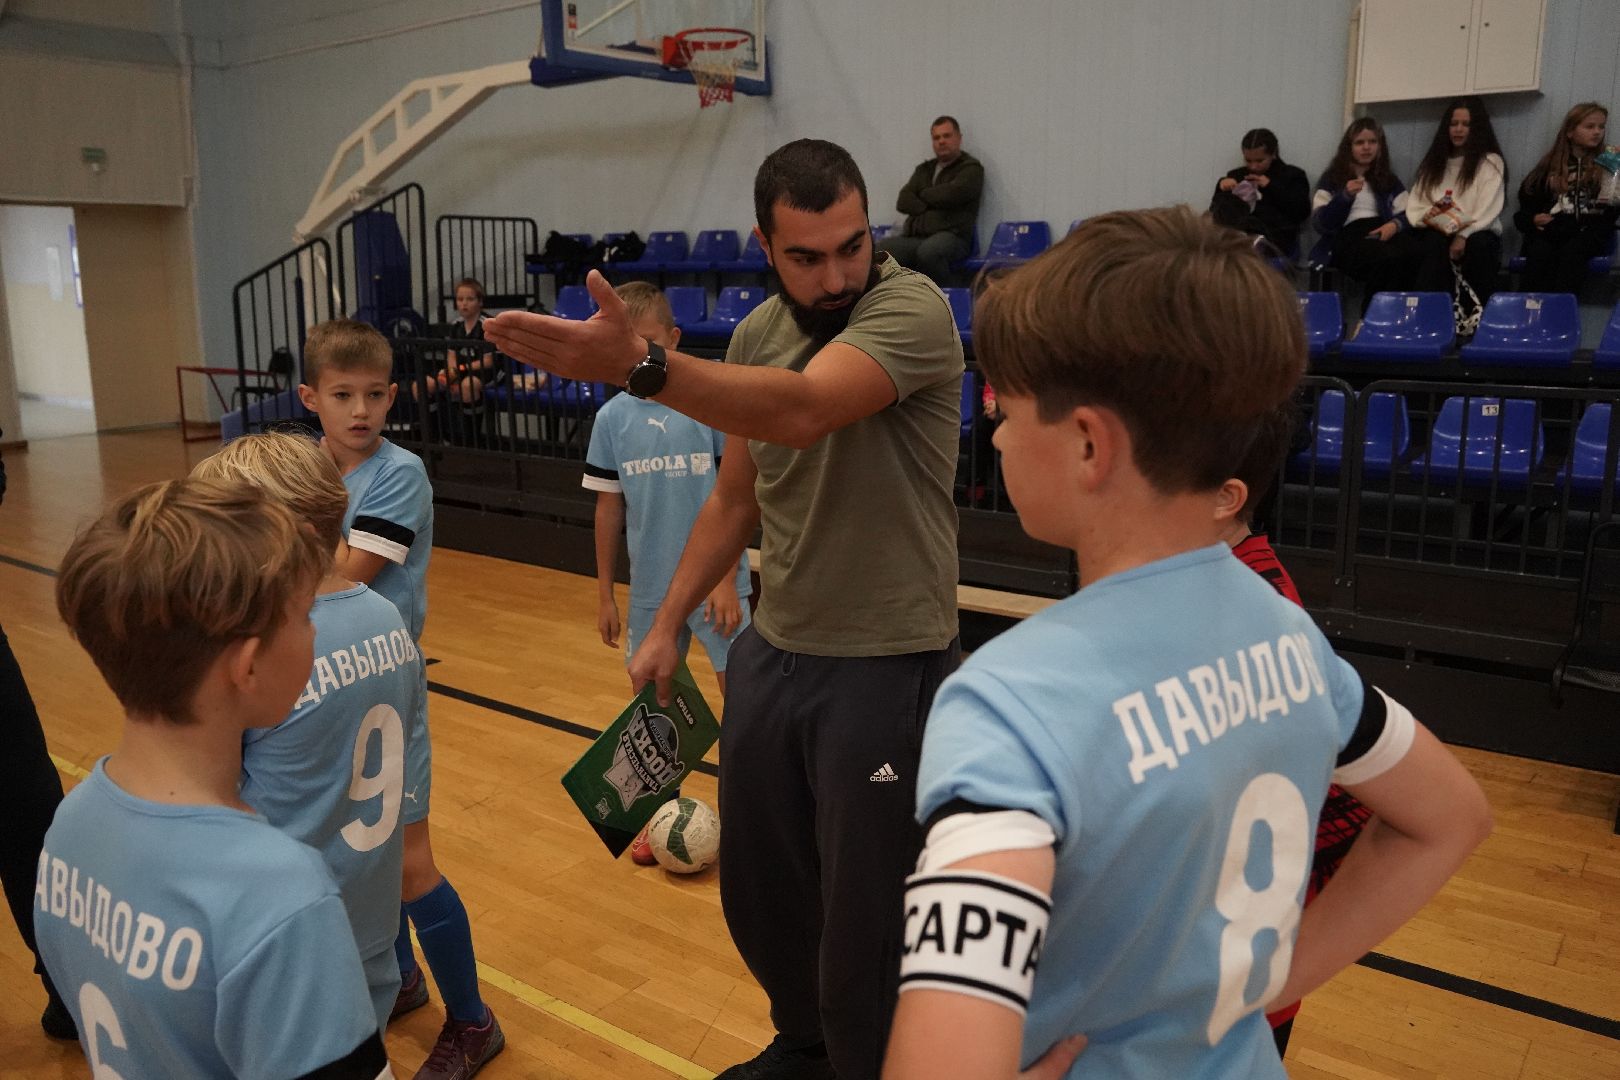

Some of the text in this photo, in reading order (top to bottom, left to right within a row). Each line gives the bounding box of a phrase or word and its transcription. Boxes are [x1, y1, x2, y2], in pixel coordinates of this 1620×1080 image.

[622, 455, 687, 476] TEGOLA
[676, 695, 695, 726] ФУТБОЛ
[340, 703, 404, 852] 9
[621, 734, 659, 791] ТАКТИЧЕСКАЯ
[628, 715, 680, 785] ДОСКА
[869, 774, 899, 782] adidas
[1207, 773, 1309, 1047] 8
